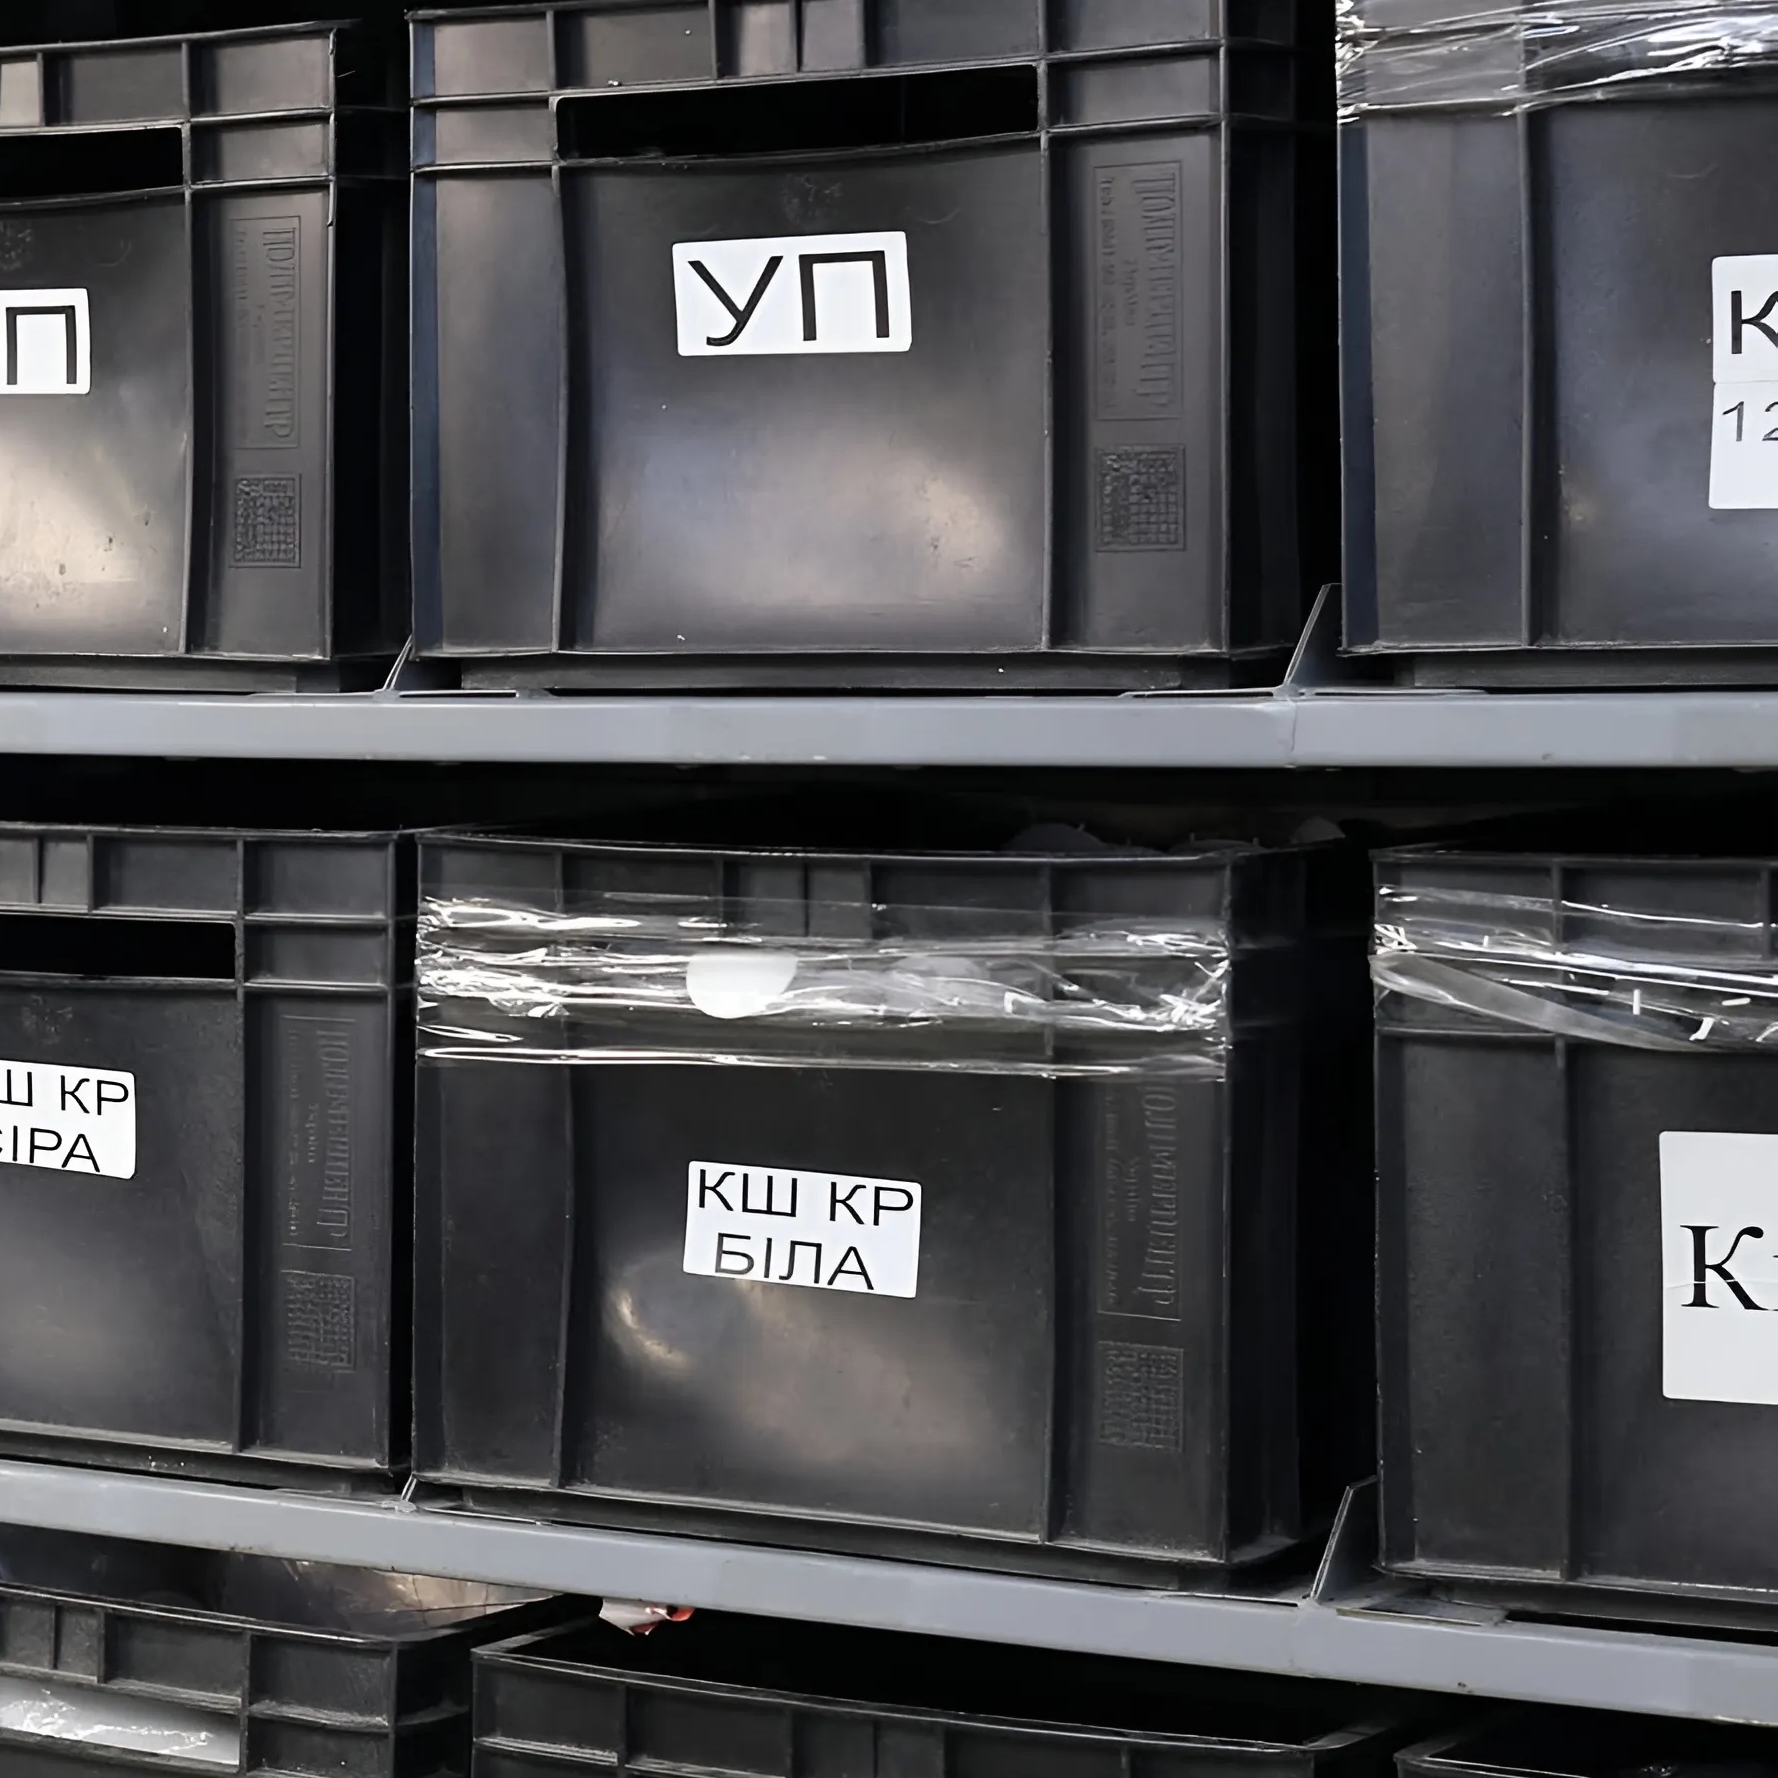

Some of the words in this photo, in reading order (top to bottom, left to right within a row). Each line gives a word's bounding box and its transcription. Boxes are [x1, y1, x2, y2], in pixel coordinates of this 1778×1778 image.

[688, 250, 890, 346] УП
[61, 1075, 129, 1116] КР
[698, 1169, 798, 1217] КШ
[829, 1181, 914, 1226] КР
[714, 1232, 874, 1290] БІЛА
[1679, 1224, 1778, 1311] К
